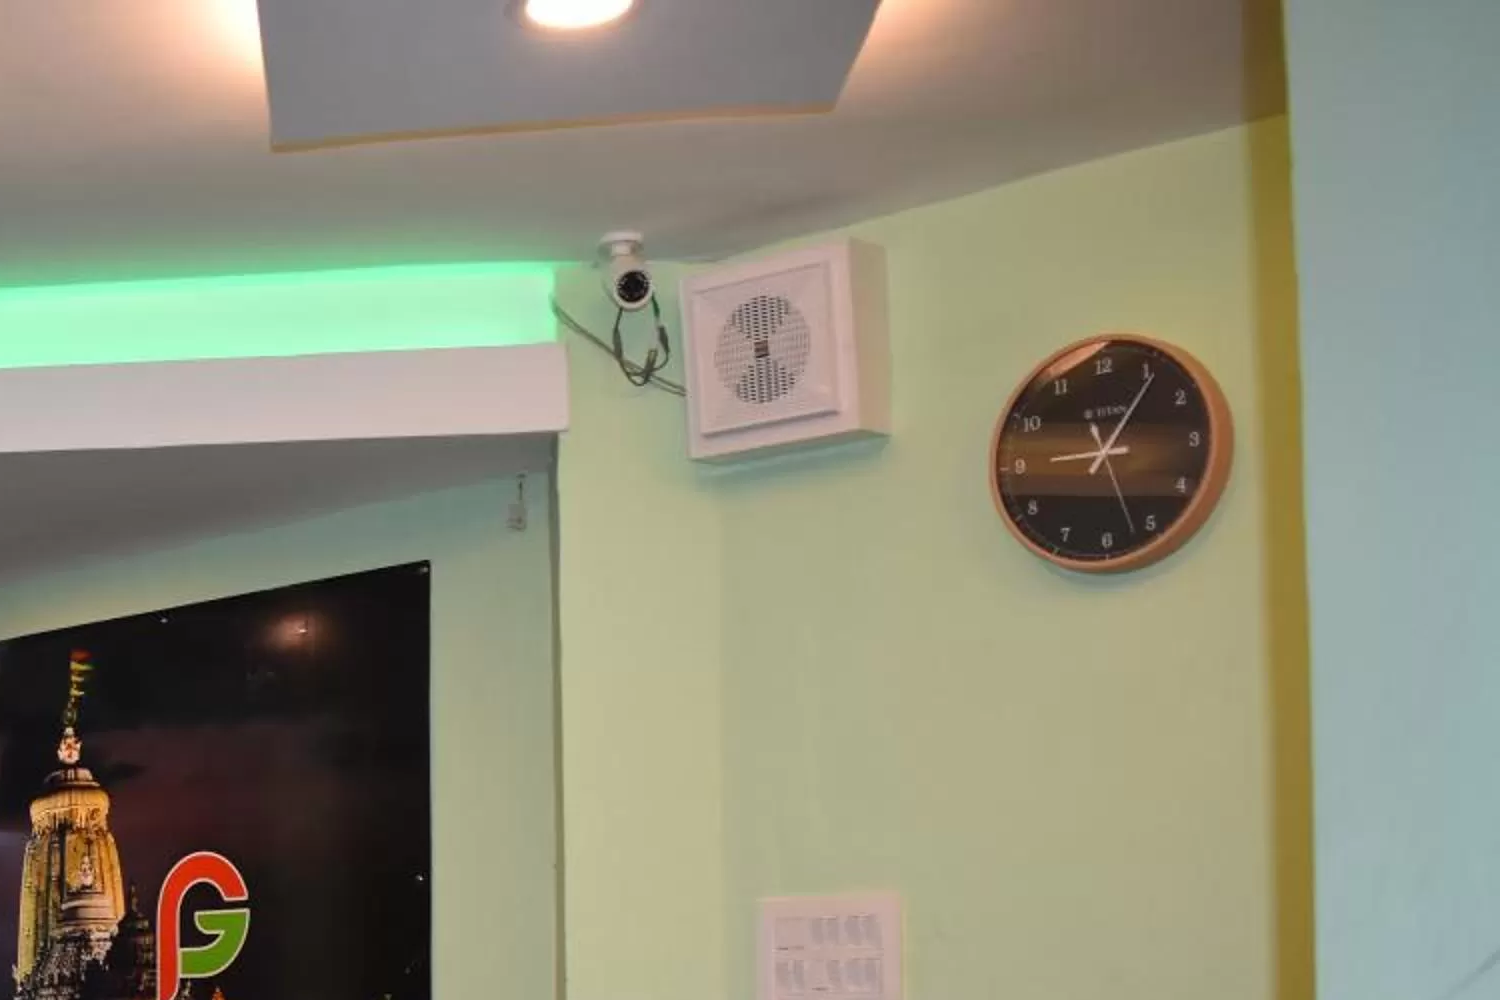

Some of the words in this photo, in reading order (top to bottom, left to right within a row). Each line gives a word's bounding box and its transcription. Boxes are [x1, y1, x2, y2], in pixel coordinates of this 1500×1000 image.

[1095, 358, 1113, 375] 12
[1141, 363, 1150, 379] 1
[1054, 379, 1068, 395] 11
[1175, 389, 1187, 405] 2
[1022, 416, 1041, 432] 10
[1189, 431, 1200, 447] 3
[1014, 458, 1026, 474] 9
[1175, 476, 1186, 492] 4
[1027, 500, 1038, 515] 8
[1146, 515, 1156, 531] 5
[1060, 527, 1071, 541] 7
[1102, 533, 1113, 548] 6
